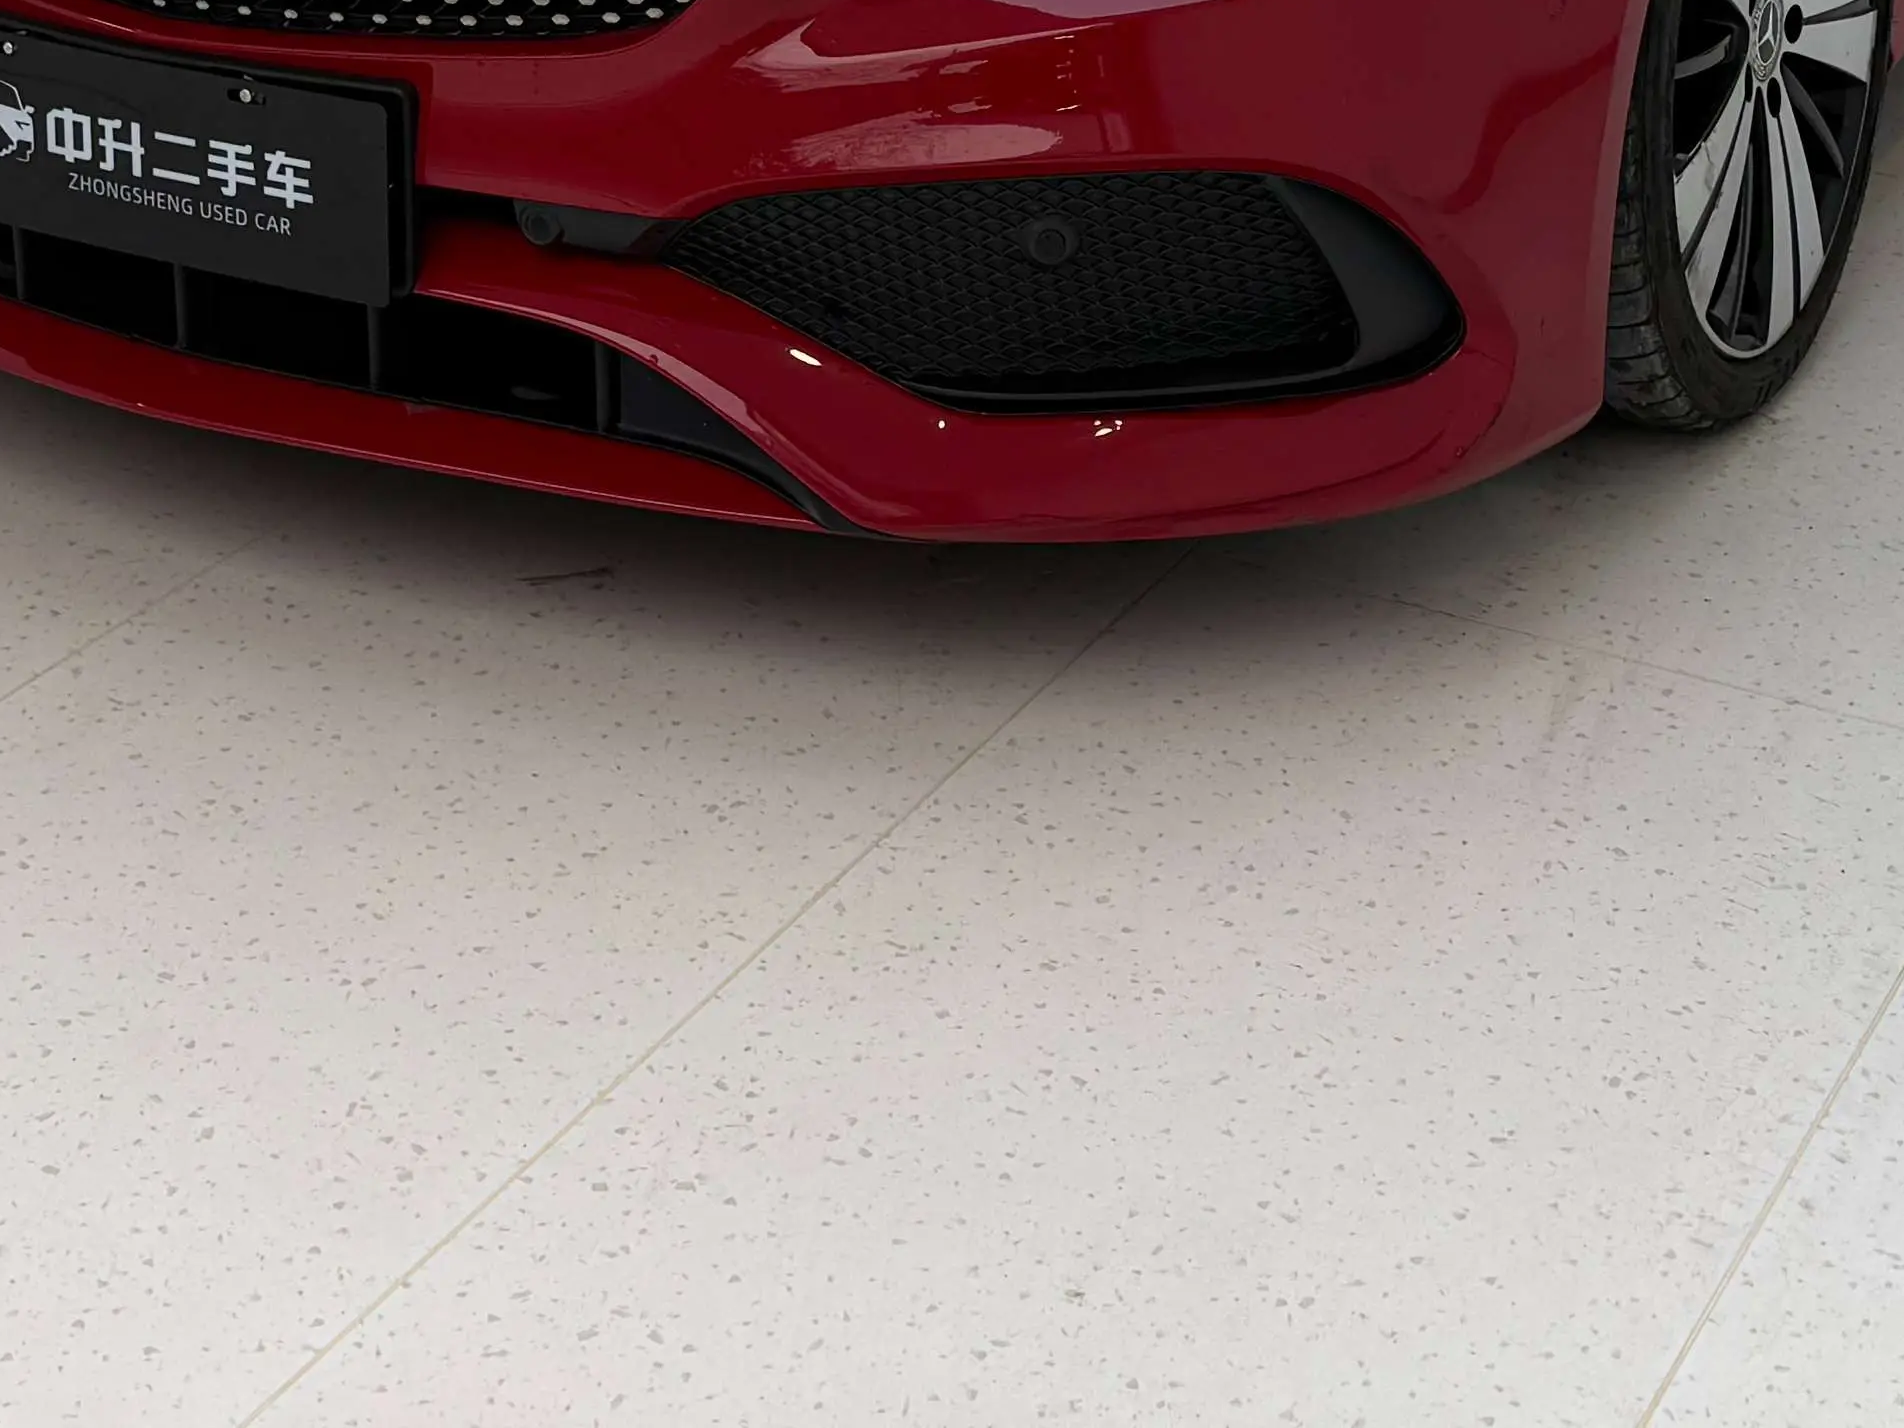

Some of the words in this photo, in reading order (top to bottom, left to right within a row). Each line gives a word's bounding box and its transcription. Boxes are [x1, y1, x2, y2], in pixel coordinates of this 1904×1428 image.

[46, 106, 314, 210] 中升二手车
[68, 172, 194, 216] ZHONGSHENG
[199, 201, 248, 227] USED
[255, 212, 292, 236] CAR
